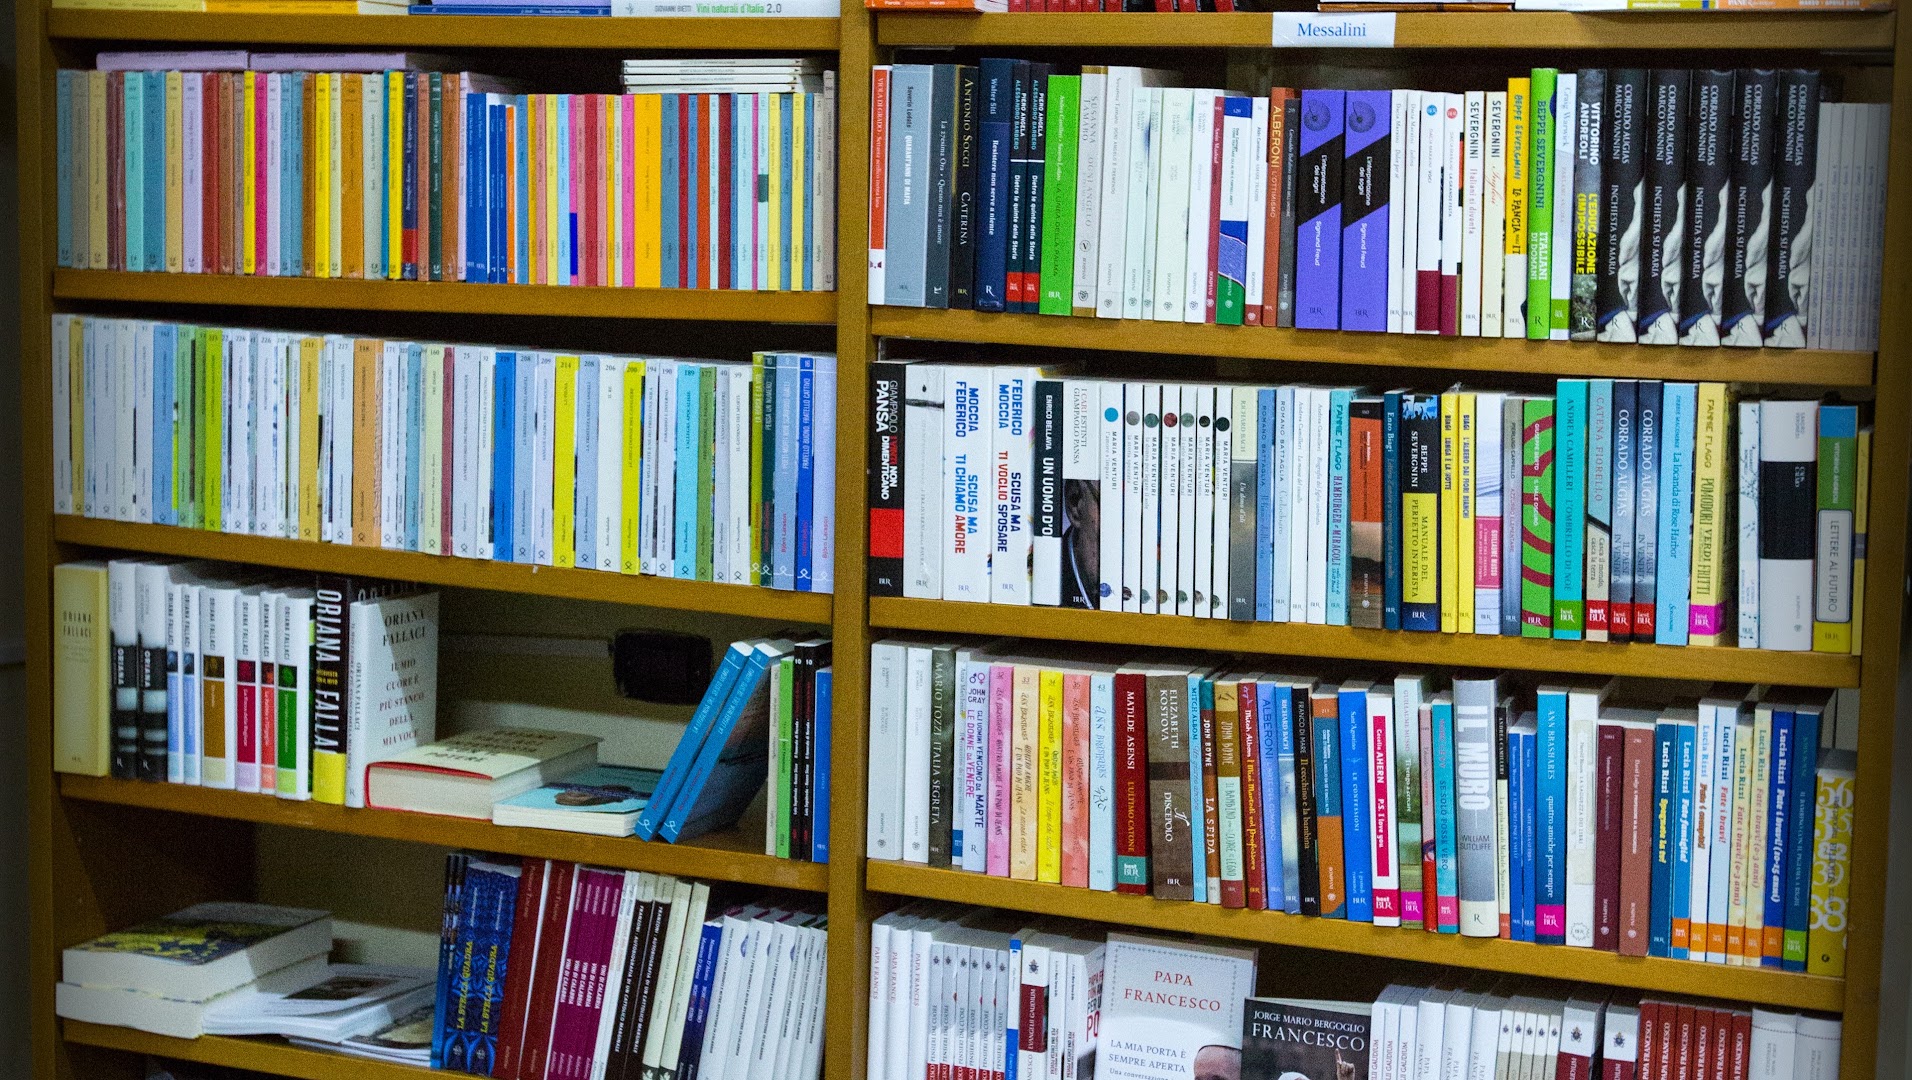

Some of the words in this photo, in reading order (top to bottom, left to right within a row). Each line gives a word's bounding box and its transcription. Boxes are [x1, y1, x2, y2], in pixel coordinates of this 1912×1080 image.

[696, 4, 709, 13] Vini
[712, 4, 739, 13] naturali
[740, 4, 764, 13] d'Italia
[766, 4, 782, 13] 2.0
[1297, 22, 1366, 37] Messalini
[963, 78, 974, 132] ANTONIO
[1612, 84, 1623, 118] MARCO
[1623, 84, 1633, 130] CORRADO
[1081, 98, 1090, 141] TAMARO
[1089, 95, 1098, 144] SUSANNA
[1491, 100, 1501, 158] SEVERGNINI
[1536, 100, 1546, 137] BEPPE
[1579, 102, 1590, 160] ANDREOLI
[1589, 102, 1601, 165] VITTORINO
[962, 135, 972, 167] SOCCI
[1270, 105, 1281, 168] ALBERONI
[1612, 119, 1622, 160] VANNINI
[1621, 131, 1632, 164] AUGIAS
[1086, 157, 1095, 185] OGNI
[1357, 178, 1365, 196] sogni
[1364, 156, 1373, 206] L'interpretazione
[1535, 138, 1546, 209] SEVERGNINI
[1085, 185, 1094, 227] ANGELO
[1269, 171, 1278, 218] L'OTTIMISMO
[1609, 184, 1620, 233] INCHIESTA
[959, 192, 971, 245] CATERINA
[1011, 203, 1019, 223] quinte
[1359, 222, 1368, 249] Sigmund
[1531, 232, 1538, 242] DI
[1575, 193, 1587, 274] (IM)POSSIBILE
[1585, 193, 1598, 274] L'EDUCAZIONE
[1609, 233, 1617, 245] SU
[1359, 251, 1367, 268] Freud
[1530, 244, 1538, 280] DOMANI
[1537, 232, 1548, 281] ITALIANI
[1607, 246, 1617, 275] MARIA
[876, 380, 889, 433] PANSA
[955, 381, 966, 438] FEDERICO
[968, 387, 978, 432] MOCCIA
[998, 384, 1009, 429] MOCCIA
[1045, 395, 1053, 419] ENRICO
[1387, 411, 1395, 431] Enzo
[1566, 398, 1575, 437] ANDREA
[1595, 396, 1605, 444] CATENA
[997, 451, 1007, 460] TI
[1386, 432, 1395, 453] Biagi
[1618, 409, 1630, 470] CORRADO
[881, 435, 890, 500] DIMENTICANO
[955, 454, 966, 464] TI
[1042, 457, 1054, 474] UN
[1410, 431, 1419, 487] SEVERGNINI
[1420, 445, 1428, 474] BEPPE
[1565, 439, 1574, 491] CAMILLERI
[1673, 452, 1682, 462] La
[1832, 442, 1840, 474] VITTORINO
[955, 467, 966, 512] CHIAMO
[997, 463, 1007, 500] VOGLIO
[1594, 447, 1604, 502] FIORELLO
[1671, 464, 1682, 499] locanda
[1831, 475, 1839, 504] ANDREOLI
[967, 474, 978, 513] SCUSA
[1042, 477, 1054, 512] UOMO
[1617, 472, 1629, 516] AUGIAS
[967, 516, 978, 534] MA
[997, 504, 1007, 552] SPOSARE
[1411, 499, 1419, 547] PERFETTO
[1563, 499, 1573, 556] L'OMBRELLO
[1671, 508, 1681, 527] Rose
[954, 515, 965, 554] AMORE
[1421, 516, 1429, 562] MANUALE
[1669, 528, 1680, 559] Harbor
[1829, 520, 1840, 557] LETTERE
[1410, 549, 1419, 598] INTERISTA
[1420, 564, 1428, 582] DEL
[1564, 559, 1572, 570] DI
[1829, 561, 1839, 573] AL
[1563, 571, 1573, 591] NOÈ
[1828, 575, 1839, 612] FUTURO
[63, 611, 92, 624] ORIANA
[63, 626, 92, 638] FALLACI
[384, 610, 425, 627] ORIANA
[383, 626, 427, 646] FALLACI
[391, 661, 399, 672] IL
[401, 659, 416, 670] MIO
[933, 662, 944, 701] MARIO
[379, 698, 393, 712] PIÙ
[395, 692, 425, 706] STANCO
[966, 709, 975, 720] LE
[1126, 691, 1136, 732] MATILDE
[1159, 690, 1169, 741] KOSTOVA
[389, 715, 415, 727] DELLA
[933, 704, 943, 736] TOZZI
[1169, 689, 1179, 749] ELIZABETH
[1203, 719, 1211, 739] JOHN
[1457, 705, 1489, 733] IL
[1547, 710, 1555, 728] ANN
[383, 736, 397, 747] MIA
[399, 731, 418, 743] VOCE
[966, 722, 975, 750] DONNE
[1126, 735, 1135, 769] ASENSI
[1778, 729, 1788, 759] Lucia
[932, 742, 942, 776] ITALIA
[975, 746, 983, 782] VENGONO
[1204, 744, 1212, 767] BOYNE
[1375, 751, 1386, 784] AHERN
[1547, 730, 1555, 780] BRASHARES
[1660, 742, 1670, 767] Lucia
[965, 762, 975, 798] VENERE
[1458, 742, 1490, 810] MURO
[1659, 769, 1670, 794] Rizzi
[1777, 762, 1787, 784] Rizzi
[931, 780, 941, 825] SEGRETA
[975, 794, 984, 828] MARTE
[1127, 781, 1135, 818] L'ULTIMO
[1205, 798, 1215, 812] LA
[1377, 798, 1385, 812] P.S.
[1546, 795, 1555, 824] quattro
[1775, 788, 1785, 809] Fate
[1163, 792, 1173, 842] DISCEPOLO
[1377, 818, 1386, 833] love
[1773, 817, 1784, 845] bravi!
[1127, 820, 1135, 852] CATONE
[1205, 818, 1216, 855] SFIDA
[1376, 835, 1385, 848] you
[1547, 825, 1556, 853] amiche
[1545, 855, 1554, 868] per
[1545, 869, 1555, 898] sempre
[1771, 876, 1781, 902] anni)
[635, 905, 644, 933] FRANZONI
[627, 936, 639, 977] AUTOBIOGRAFIA
[1154, 970, 1193, 987] PAPA
[620, 995, 630, 1021] CATTOLICO
[1124, 988, 1221, 1012] FRANCESCO
[615, 1022, 626, 1053] MARGINALE
[1252, 1023, 1365, 1052] FRANCESCO
[1253, 1010, 1281, 1022] JORGE
[1282, 1014, 1312, 1027] MARIO
[1314, 1019, 1365, 1034] BERGOGLIO
[1108, 1054, 1146, 1067] SEMPRE
[1148, 1058, 1186, 1073] APERTA
[1110, 1039, 1122, 1048] LA
[1124, 1042, 1144, 1053] MIA
[1146, 1044, 1179, 1058] PORTA
[1180, 1048, 1187, 1059] È
